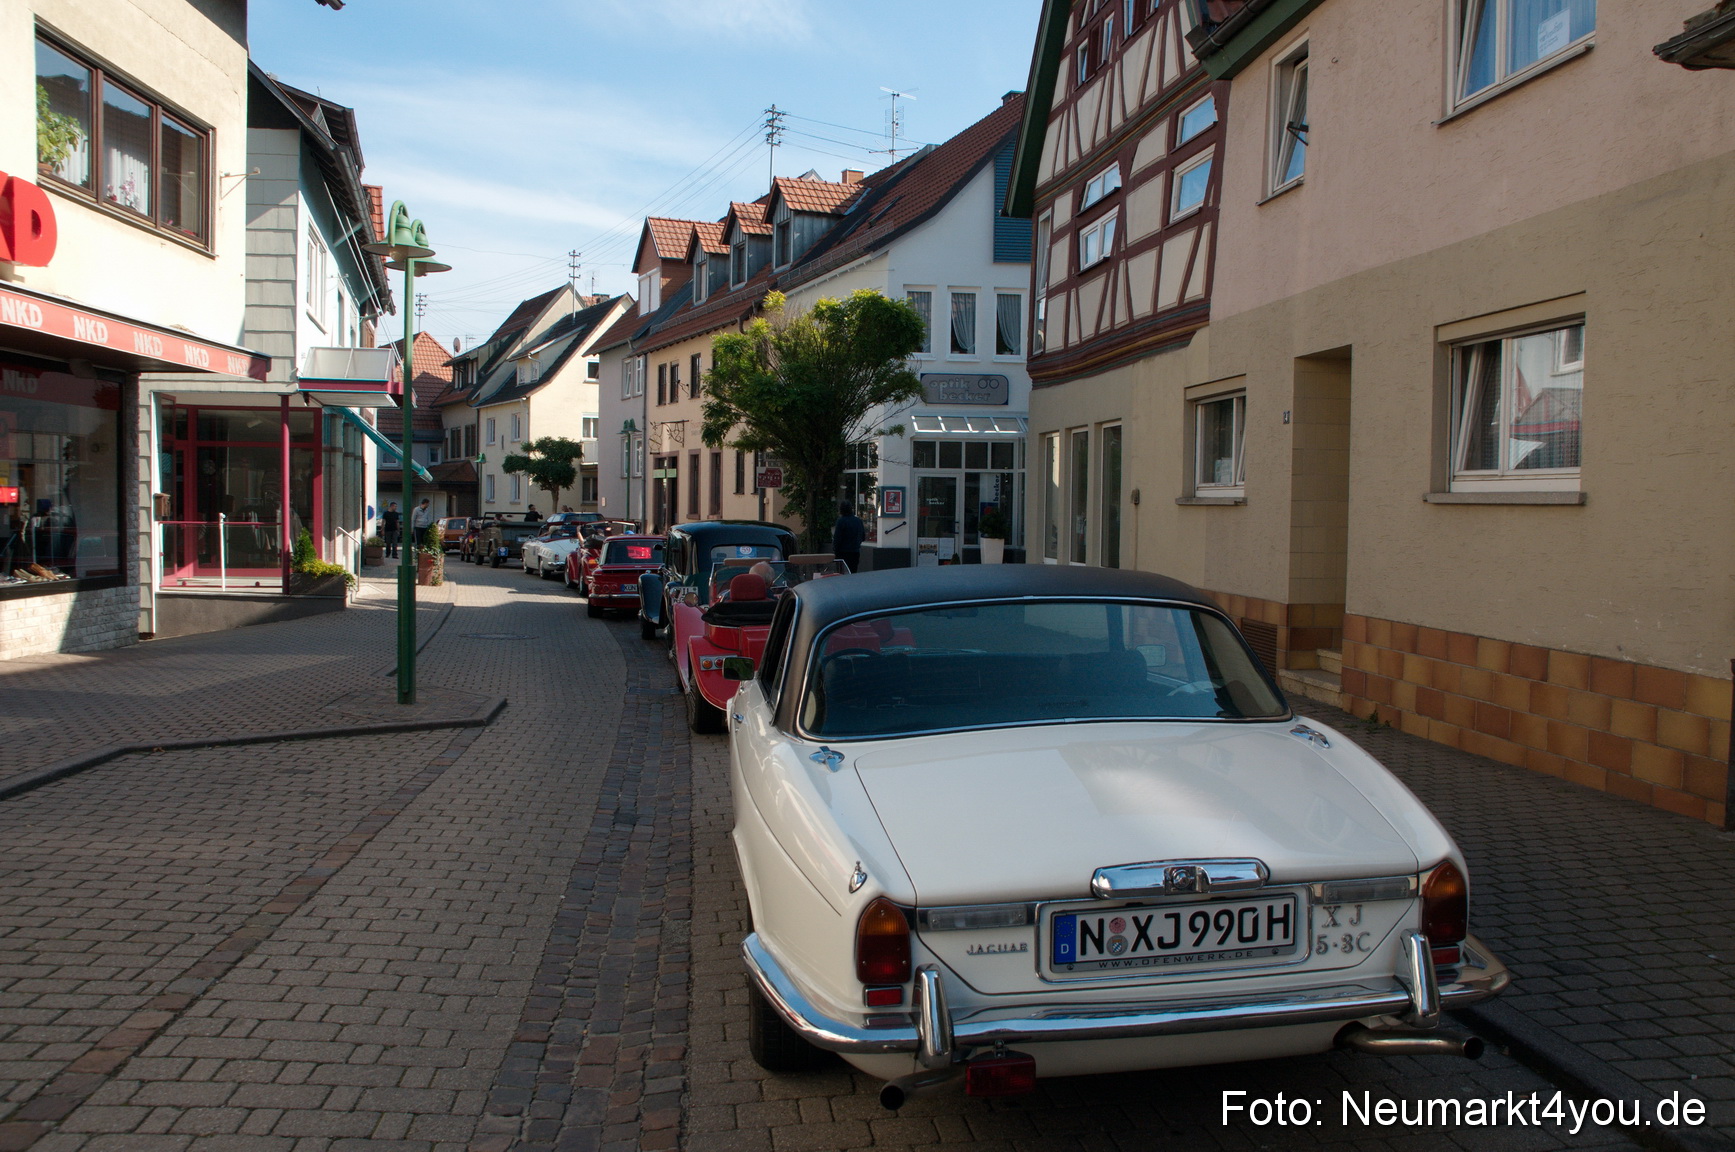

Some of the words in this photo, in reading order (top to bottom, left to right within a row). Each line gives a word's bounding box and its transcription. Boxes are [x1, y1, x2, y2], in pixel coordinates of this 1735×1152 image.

[1, 296, 43, 328] NKD
[73, 315, 109, 344] NKD
[133, 331, 163, 357] NKD
[184, 344, 210, 367] NKD
[227, 355, 249, 375] NKD
[929, 377, 970, 390] optik
[939, 389, 991, 401] becker
[1080, 918, 1105, 956] N
[966, 942, 1029, 956] JAGUAR
[1060, 943, 1070, 955] D
[1099, 950, 1254, 969] WWW.OFENWERK.DE
